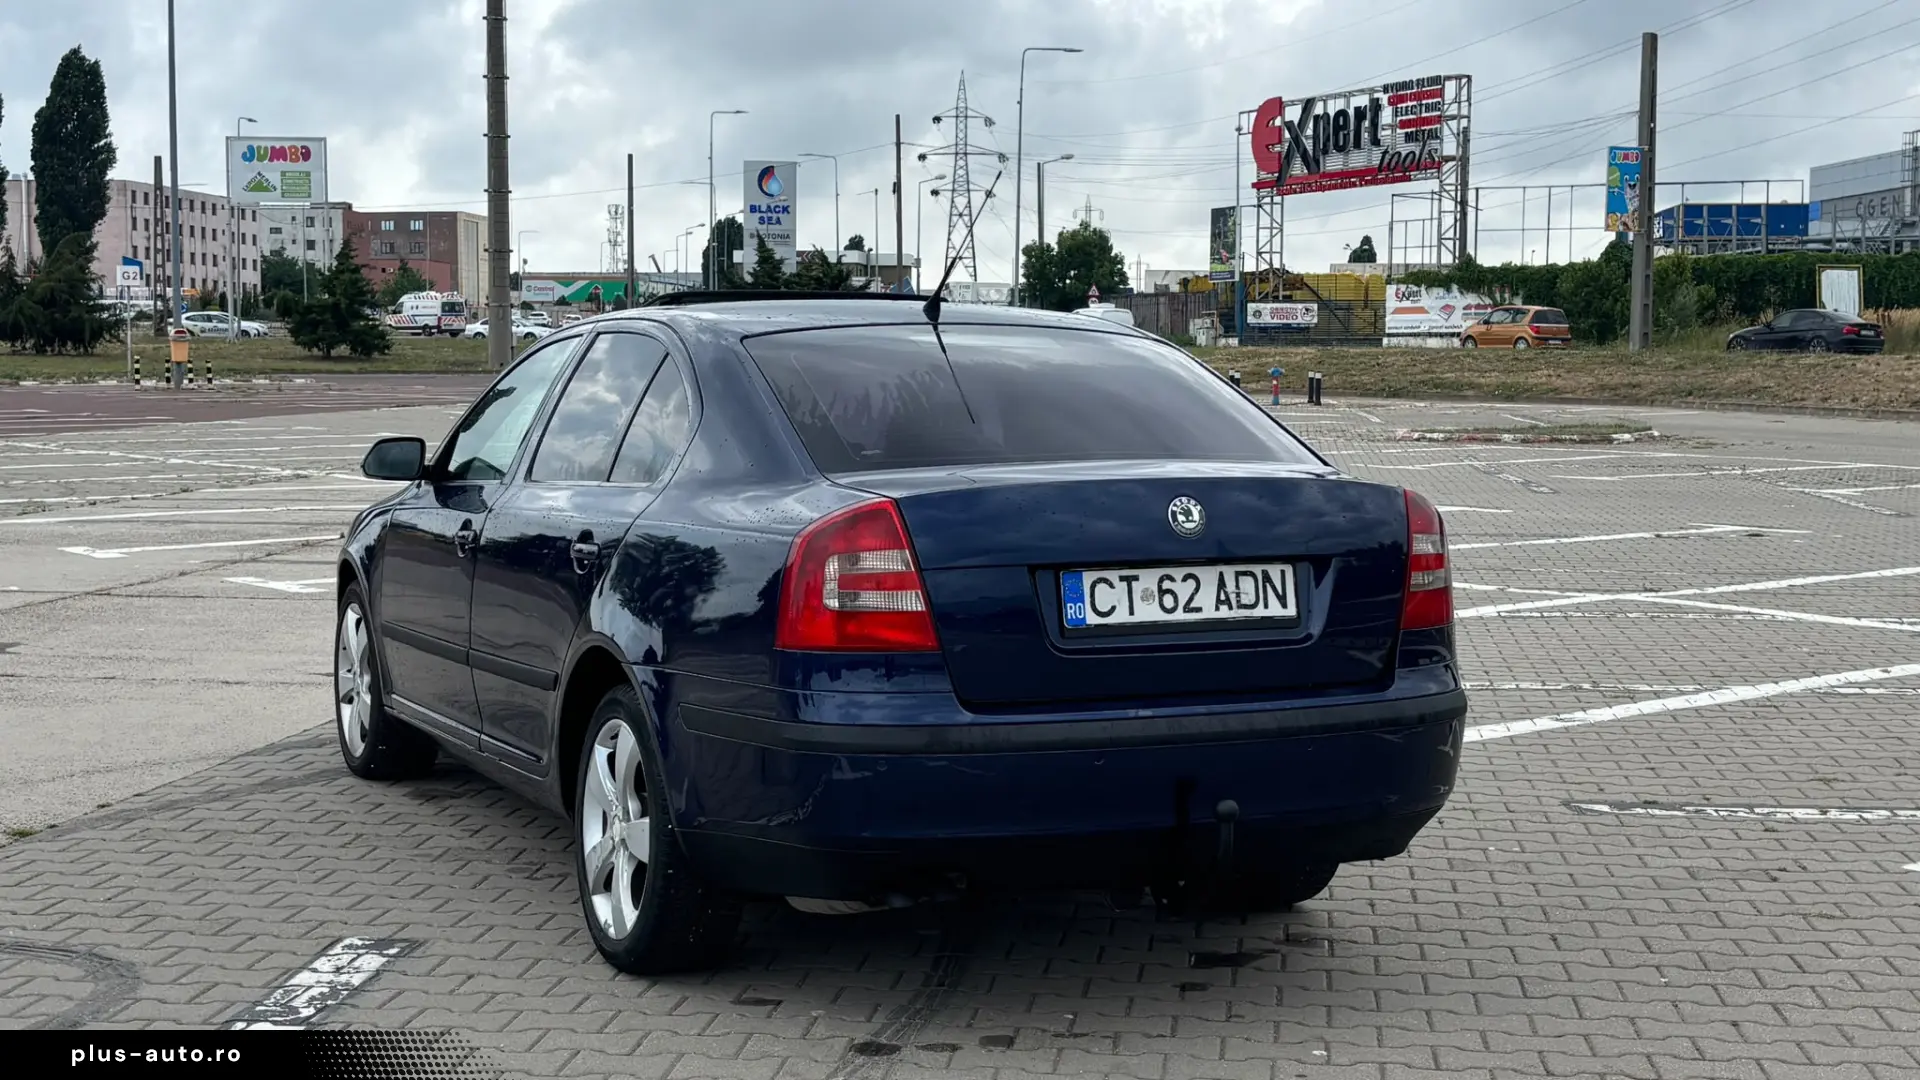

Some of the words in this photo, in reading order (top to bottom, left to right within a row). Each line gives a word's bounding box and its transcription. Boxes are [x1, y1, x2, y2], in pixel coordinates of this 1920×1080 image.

[1395, 101, 1442, 118] ELECTRIC
[1404, 127, 1442, 143] METAL
[241, 144, 312, 163] JUMBO
[1377, 138, 1438, 174] tools
[1610, 149, 1641, 164] JUMBO
[749, 204, 790, 214] BLACK
[758, 216, 782, 226] SEA
[122, 271, 138, 281] G2
[1089, 575, 1140, 618] CT
[1157, 572, 1203, 614] 62
[1214, 569, 1288, 612] ADN
[1067, 603, 1085, 620] RO
